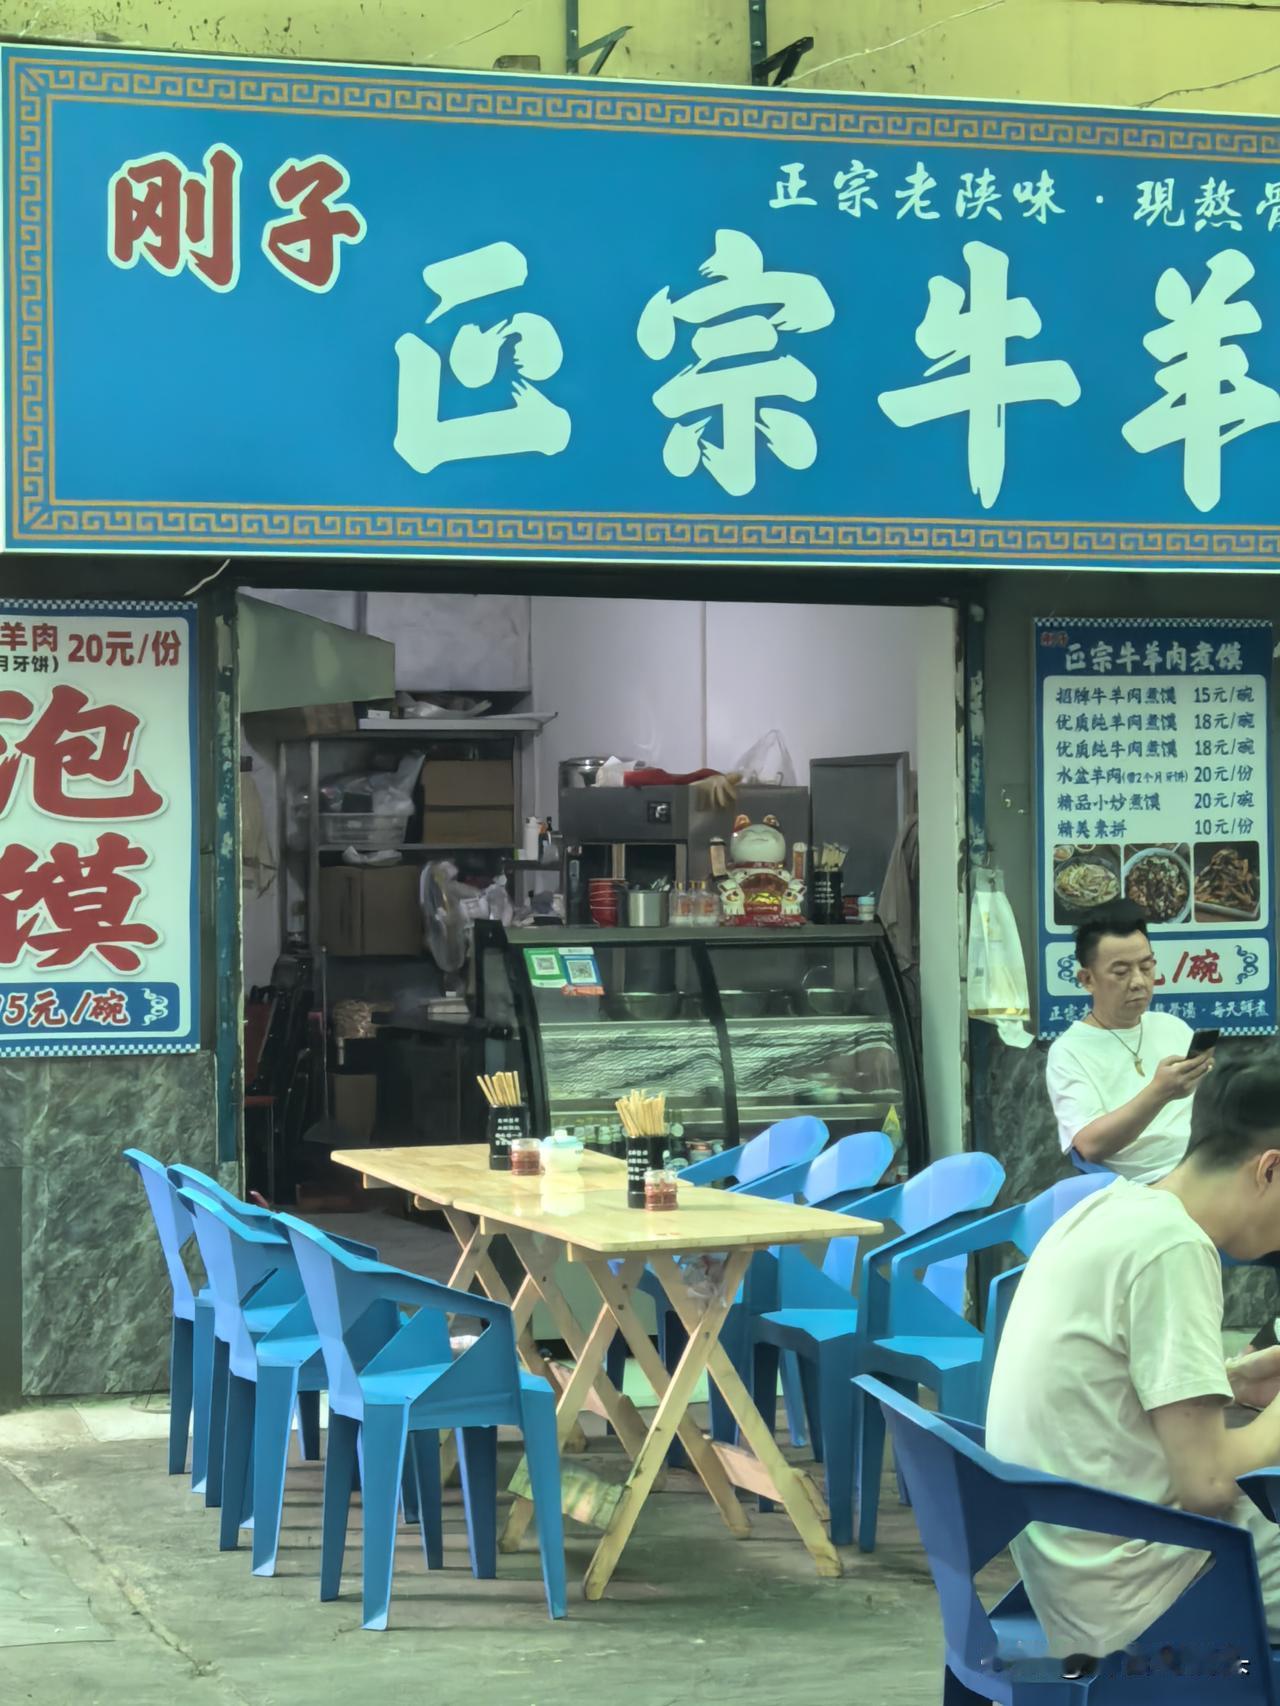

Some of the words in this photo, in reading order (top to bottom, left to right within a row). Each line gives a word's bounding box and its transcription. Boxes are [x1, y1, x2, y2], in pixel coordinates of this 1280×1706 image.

[106, 143, 368, 294] 刚子
[392, 228, 1280, 514] 正宗牛羊
[0, 621, 58, 652] 羊肉
[67, 629, 182, 668] 20元/份
[1065, 640, 1244, 674] 正宗牛羊肉煮馍
[1193, 685, 1256, 704] 15元/碗
[1055, 712, 1178, 732] 优质纯羊肉煮馍
[1193, 711, 1256, 730] 18元/碗
[1055, 739, 1178, 759] 优质纯牛肉煮馍
[1194, 737, 1256, 756] 18元/碗
[1193, 764, 1254, 783] 20元/份
[1193, 789, 1256, 809] 20元/碗
[1194, 816, 1255, 836] 10元/份
